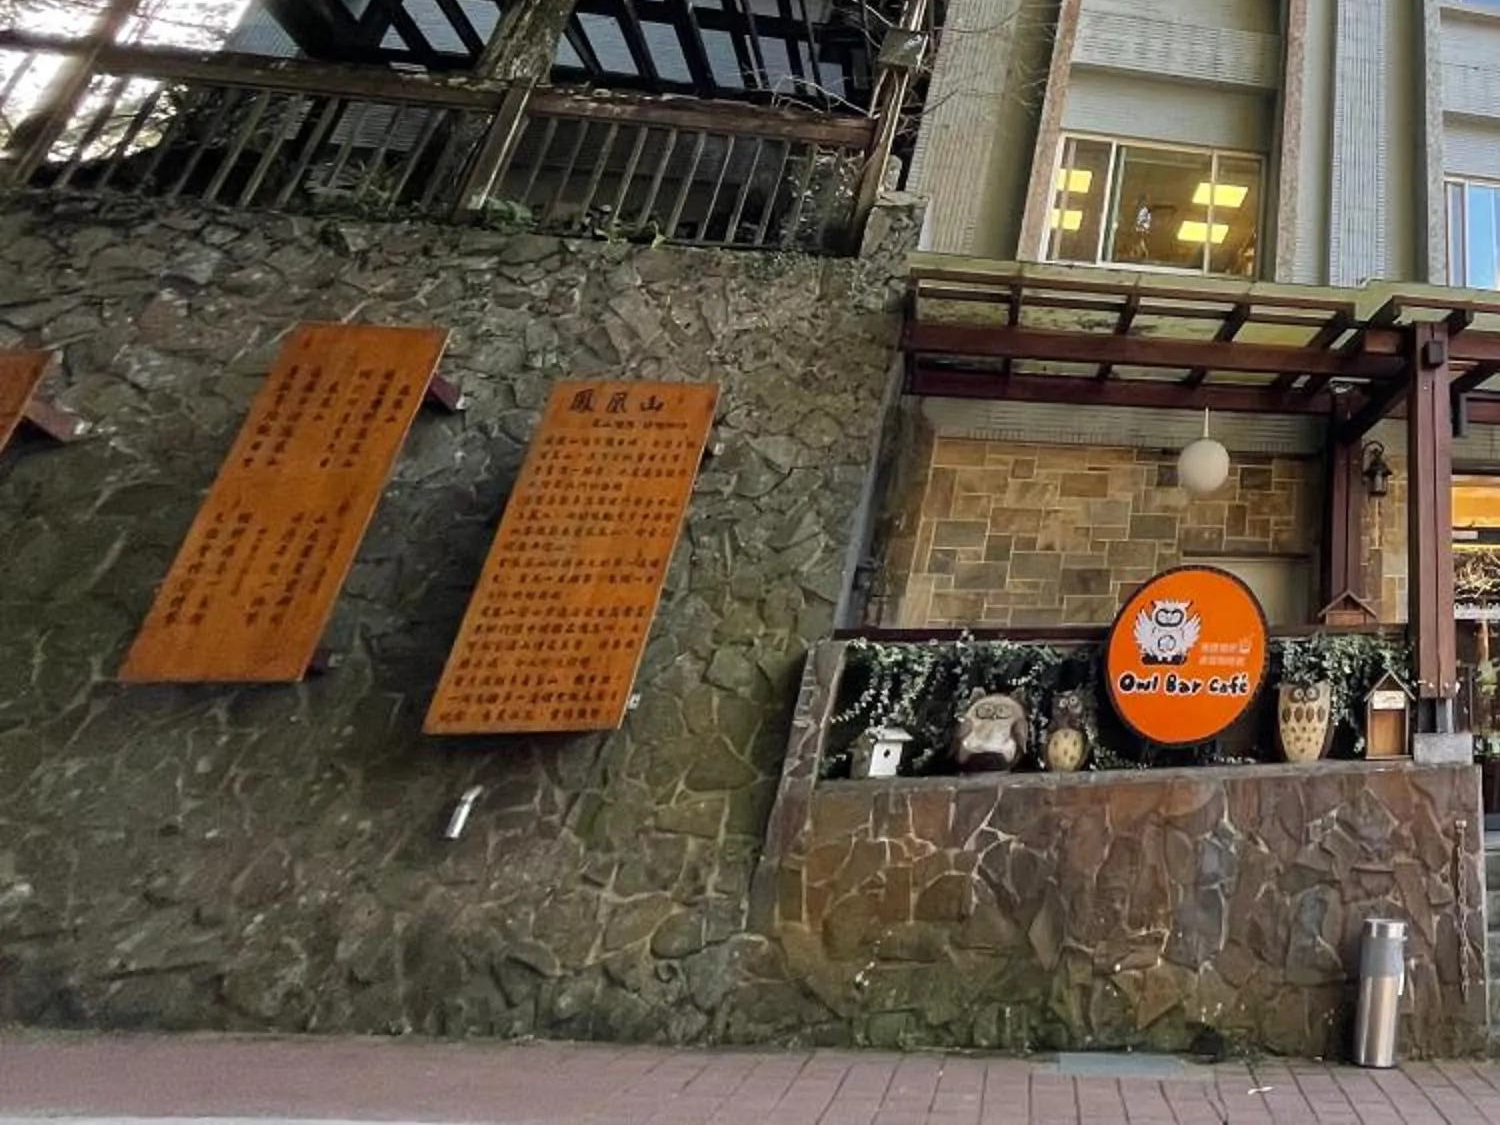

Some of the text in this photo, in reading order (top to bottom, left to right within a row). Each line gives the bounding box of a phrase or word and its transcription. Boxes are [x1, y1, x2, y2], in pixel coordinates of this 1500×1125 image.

[568, 388, 665, 413] 鳳凰山
[1118, 671, 1249, 696] Owl Bar Café
